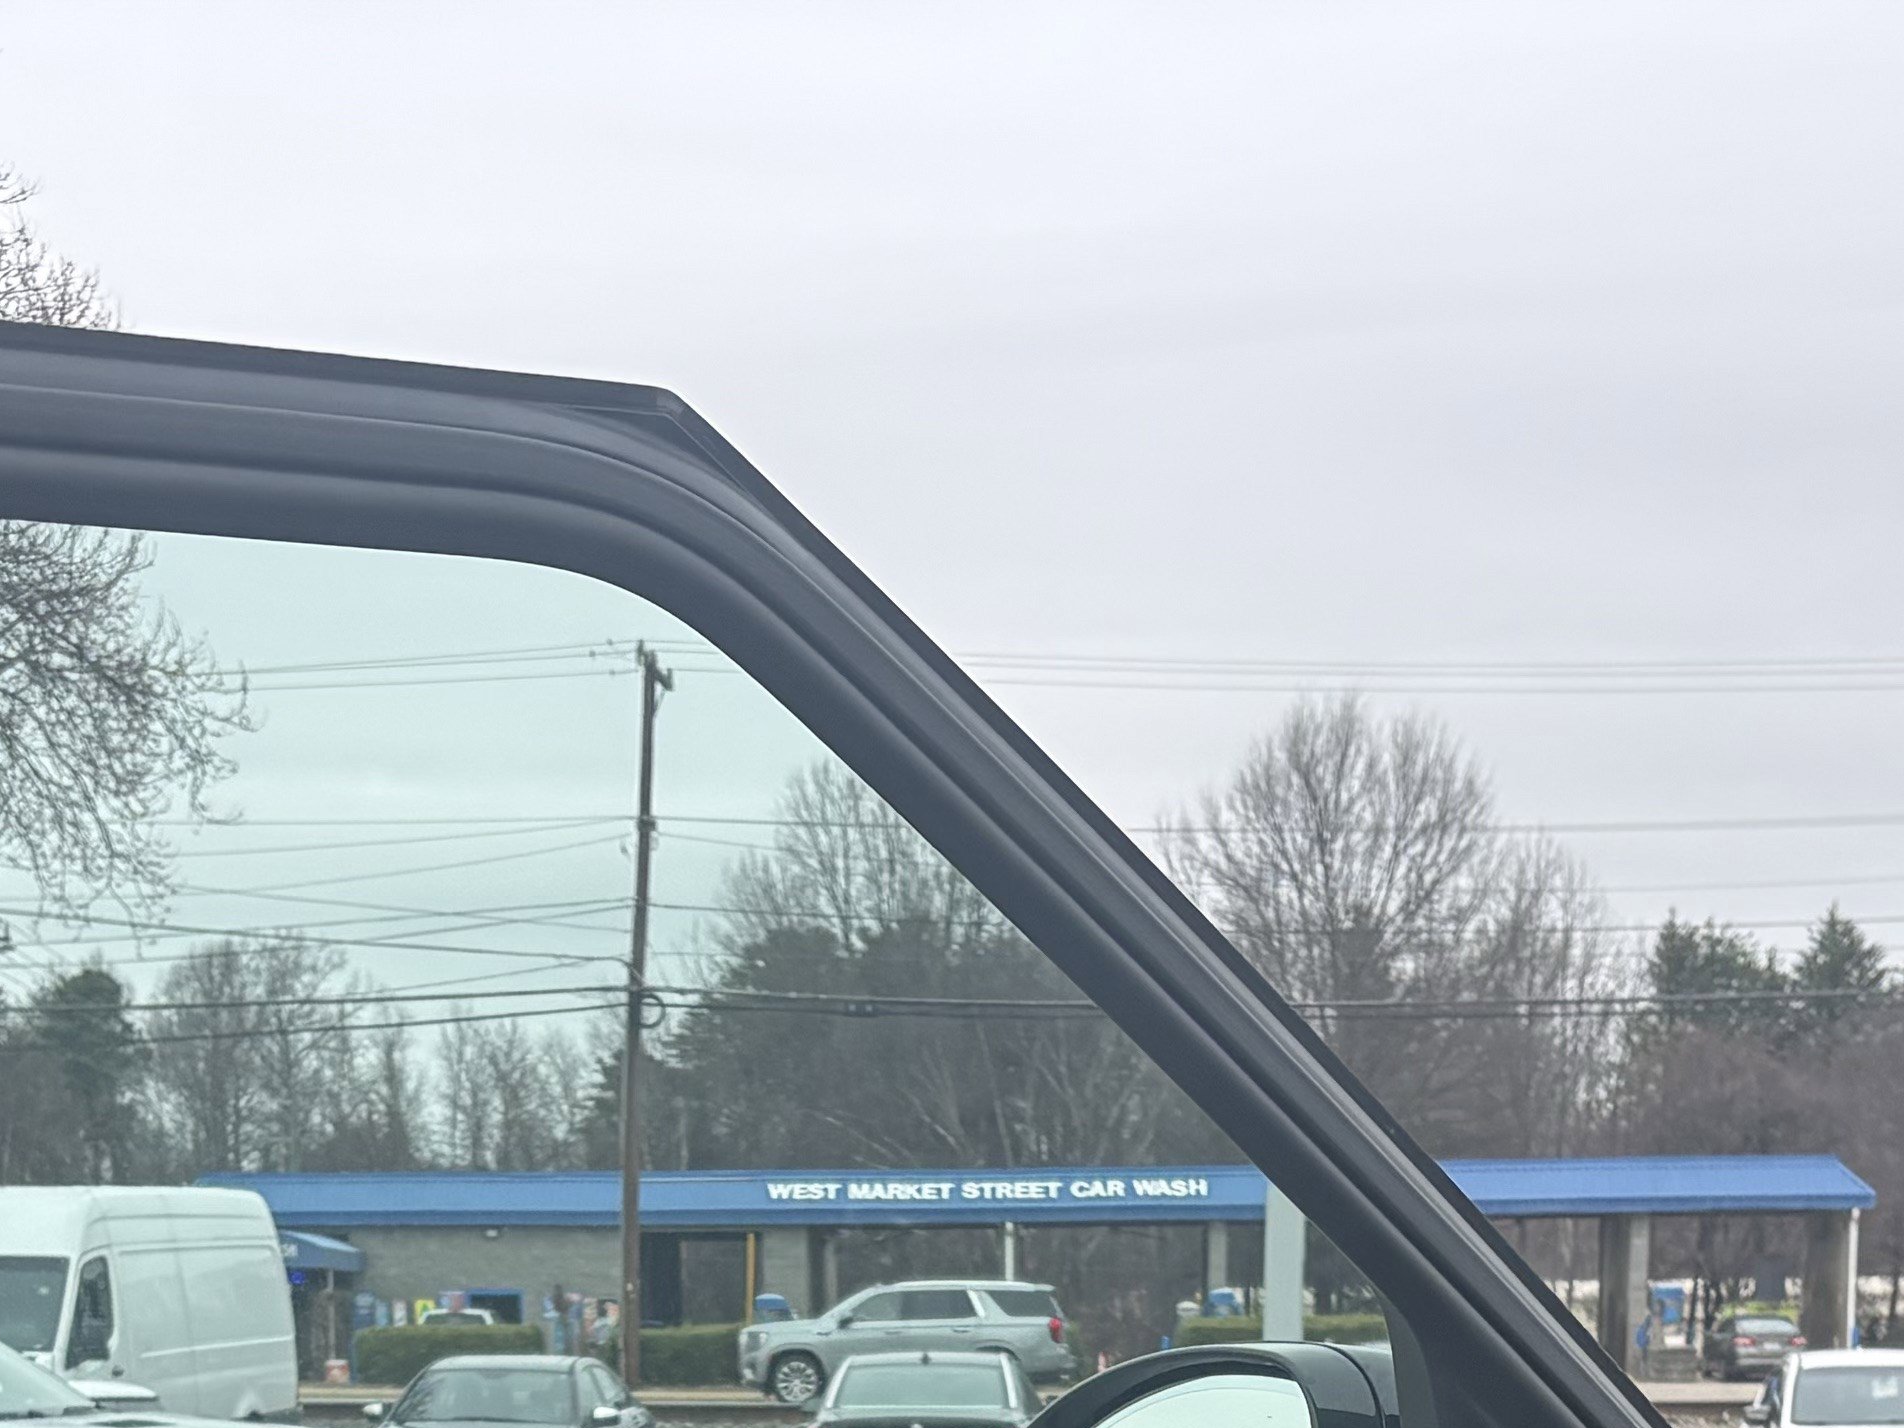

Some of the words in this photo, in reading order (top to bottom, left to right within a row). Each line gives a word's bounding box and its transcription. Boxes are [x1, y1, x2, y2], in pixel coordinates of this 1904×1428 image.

[767, 1183, 842, 1199] WEST
[847, 1182, 956, 1199] MARKET
[961, 1182, 1062, 1199] STREET
[1069, 1180, 1126, 1198] CAR
[1132, 1179, 1208, 1196] WASH
